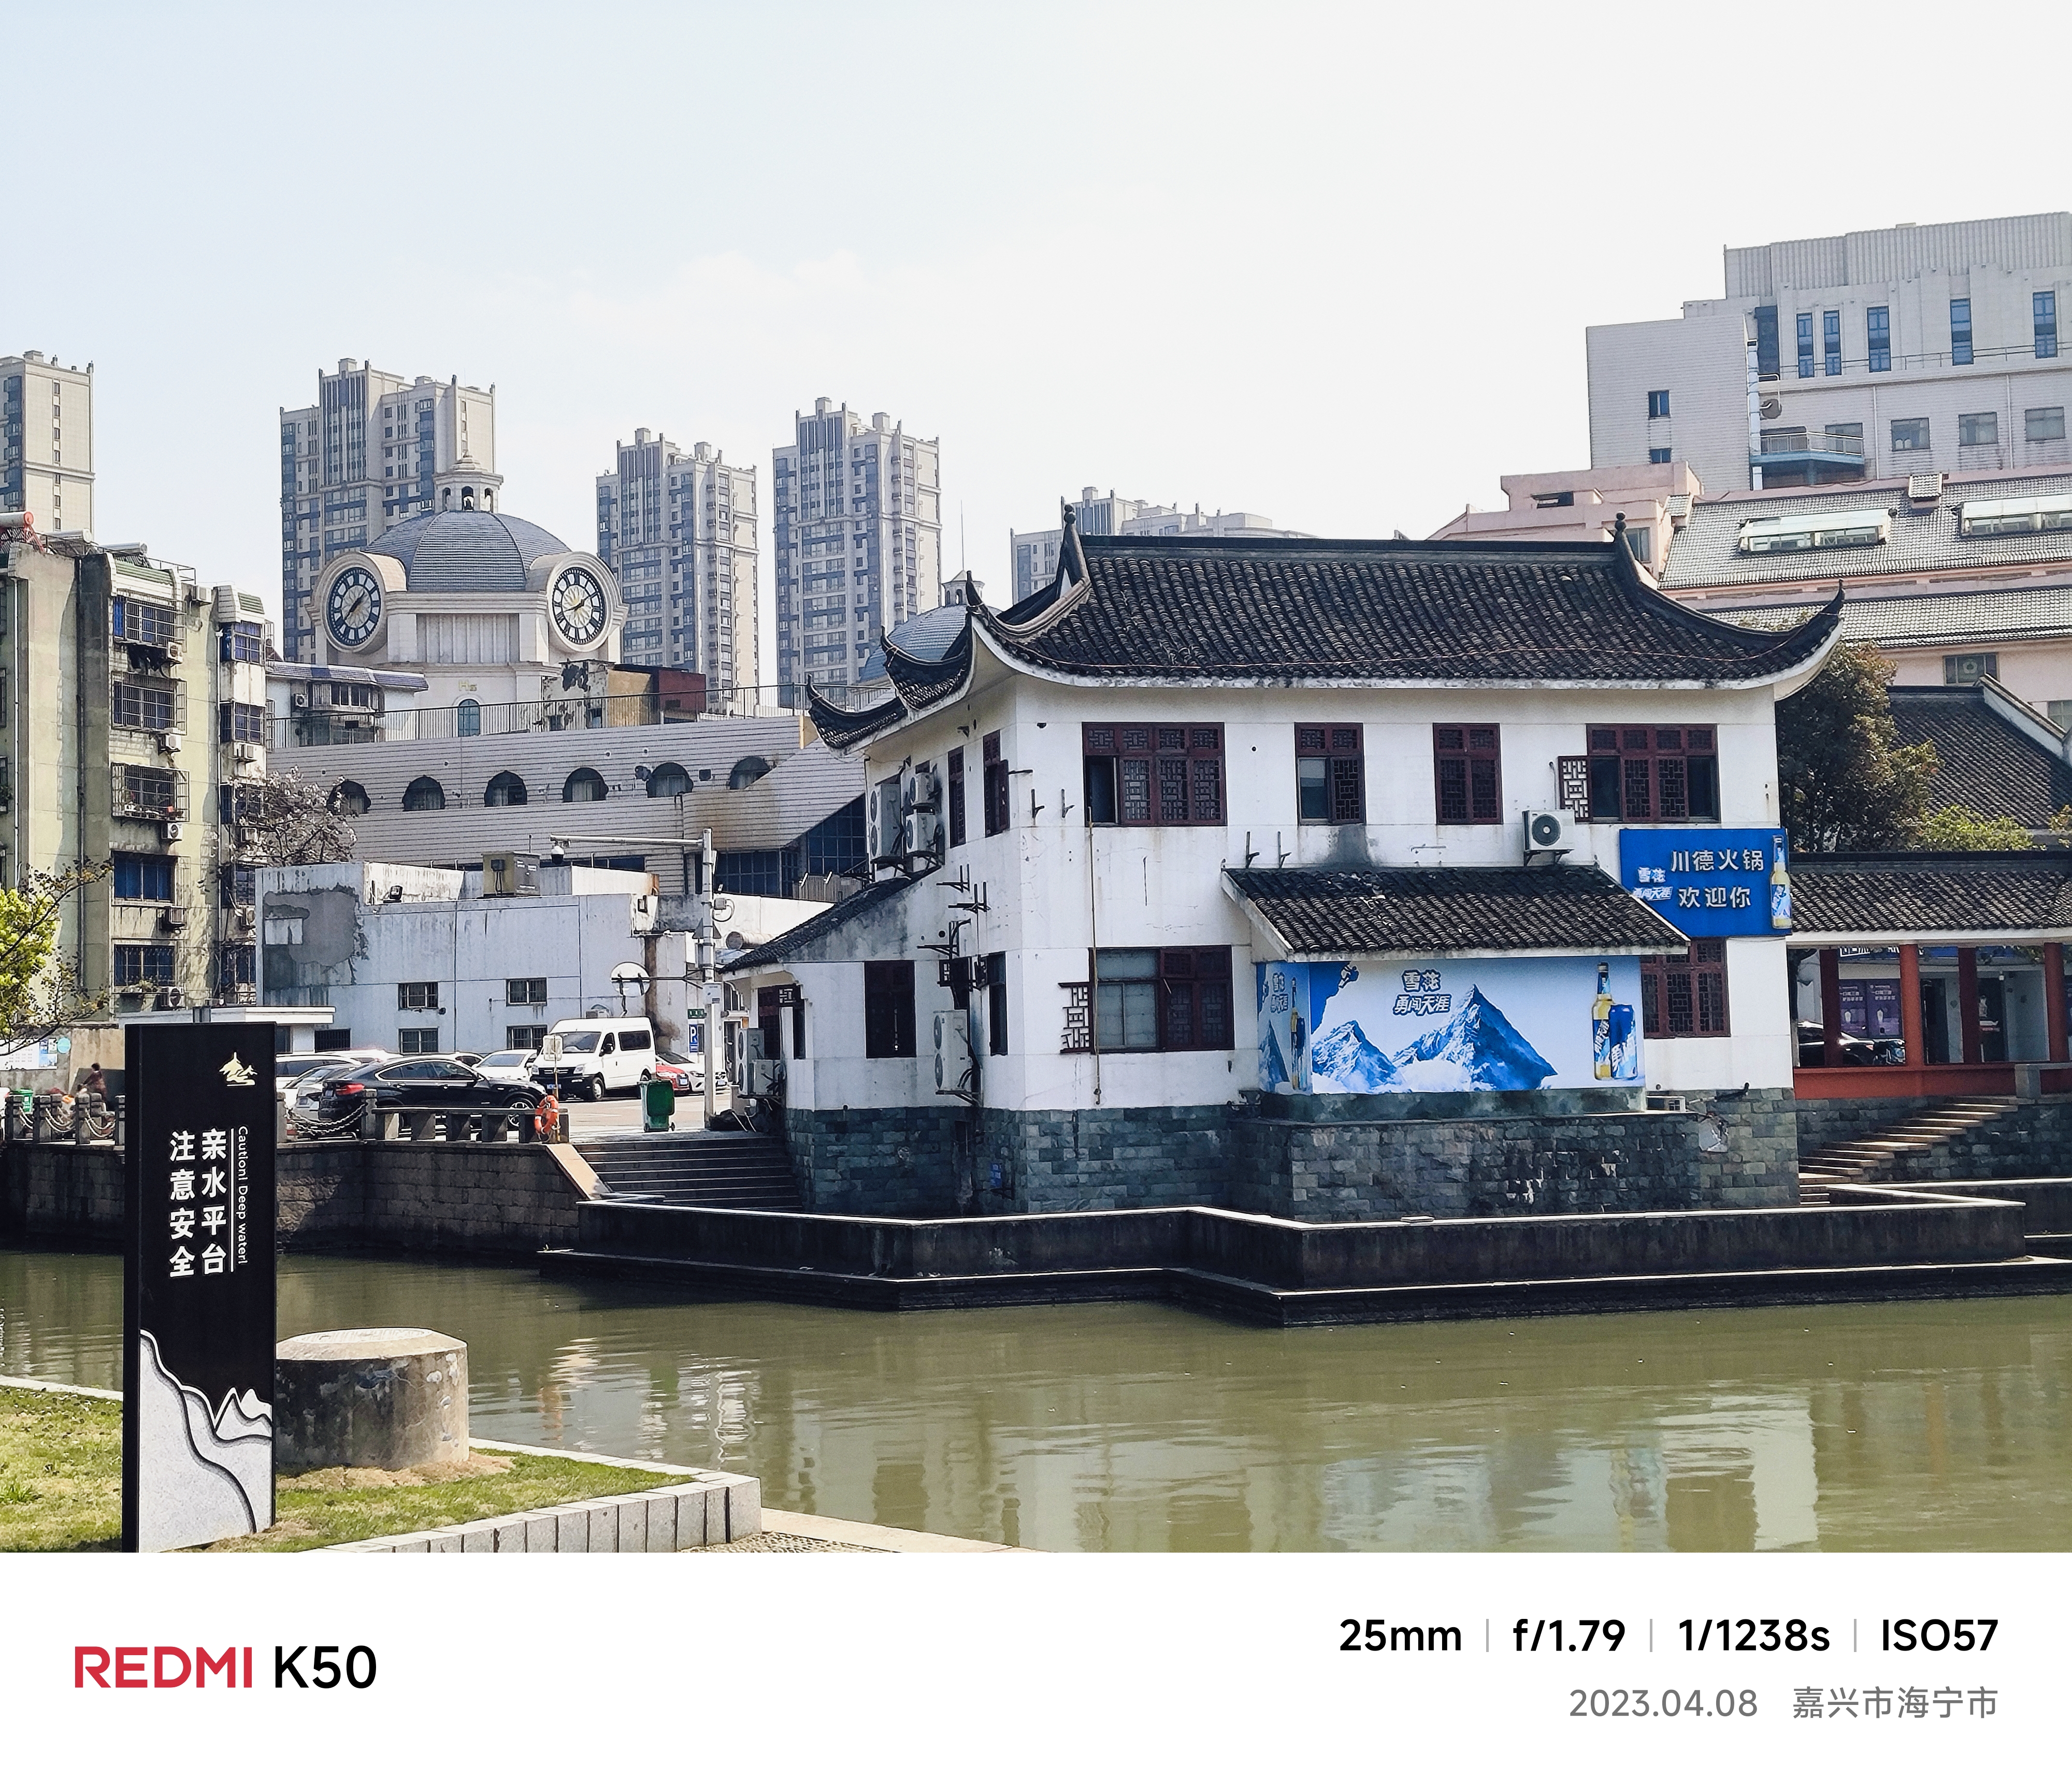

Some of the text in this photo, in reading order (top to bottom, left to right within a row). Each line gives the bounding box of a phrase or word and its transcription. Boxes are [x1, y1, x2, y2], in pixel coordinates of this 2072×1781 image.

[1671, 849, 1764, 872] 川德火锅
[1637, 866, 1666, 883] 雪花
[1678, 887, 1751, 908] 欢迎你
[1402, 970, 1441, 991] 雪花
[1393, 994, 1451, 1016] 勇闯天涯
[169, 1130, 196, 1278] 注意安全
[201, 1128, 227, 1275] 亲水平台
[236, 1185, 248, 1220] Deep
